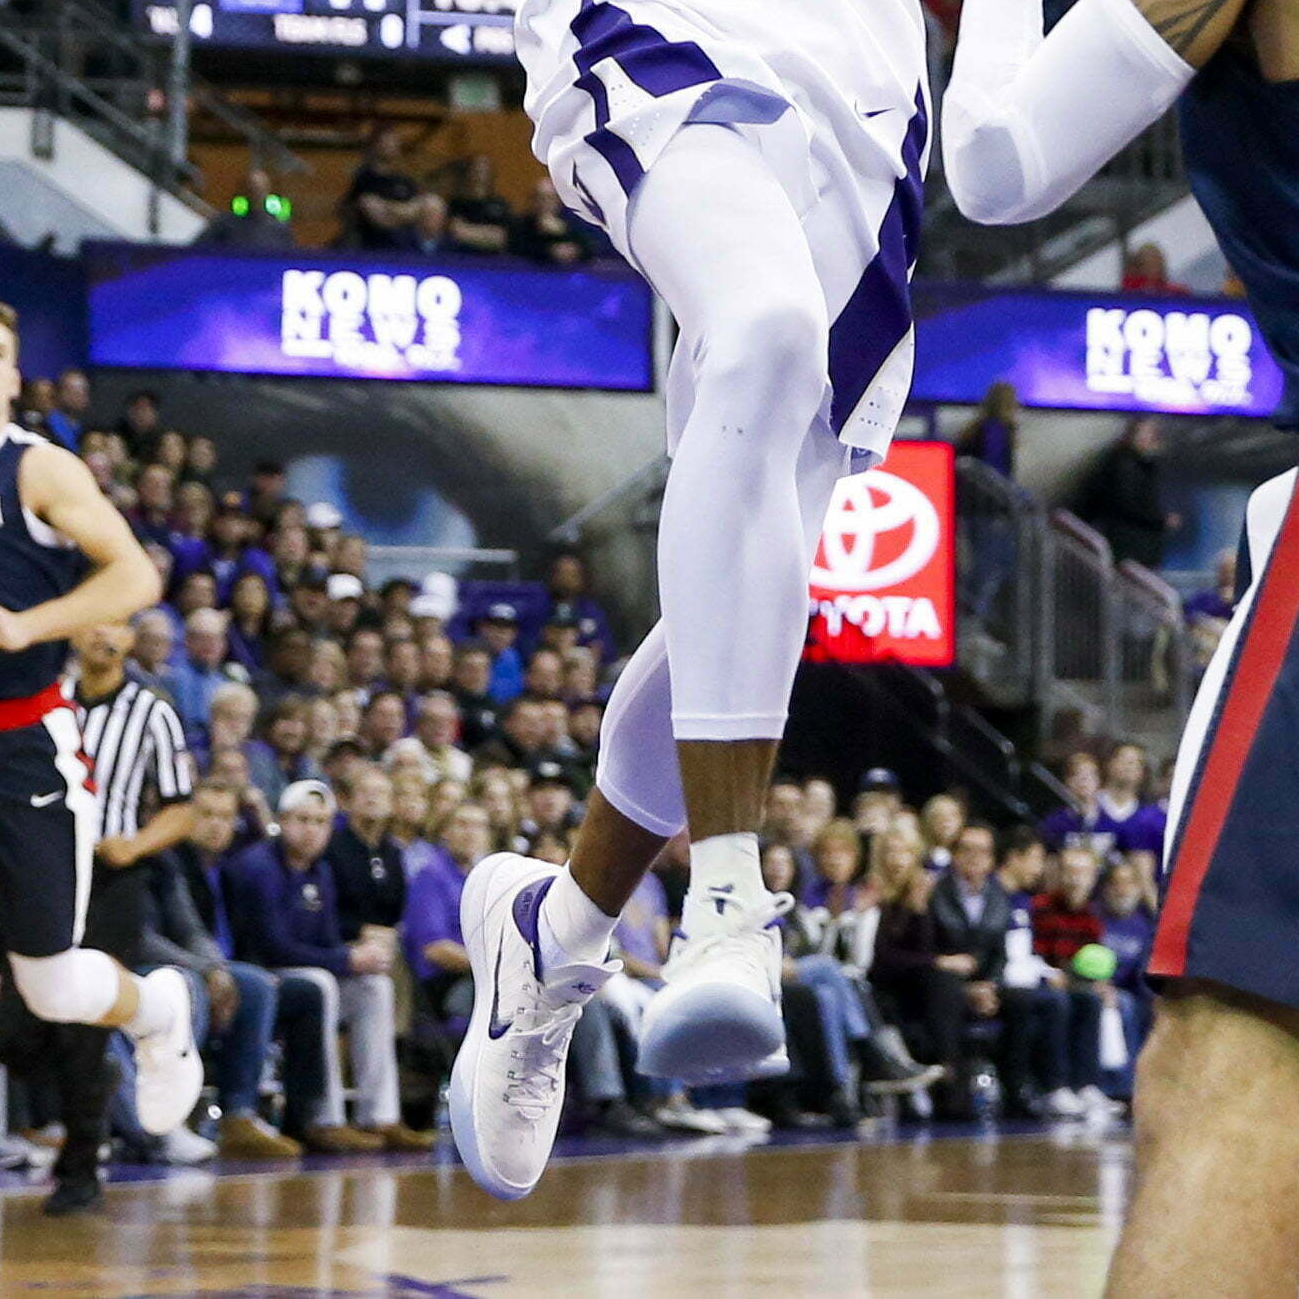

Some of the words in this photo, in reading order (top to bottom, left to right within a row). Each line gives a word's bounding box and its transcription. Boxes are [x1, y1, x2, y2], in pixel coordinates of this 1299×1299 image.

[282, 269, 463, 322] KOMO
[1086, 308, 1253, 358] KOMO
[808, 595, 941, 639] YOTA
